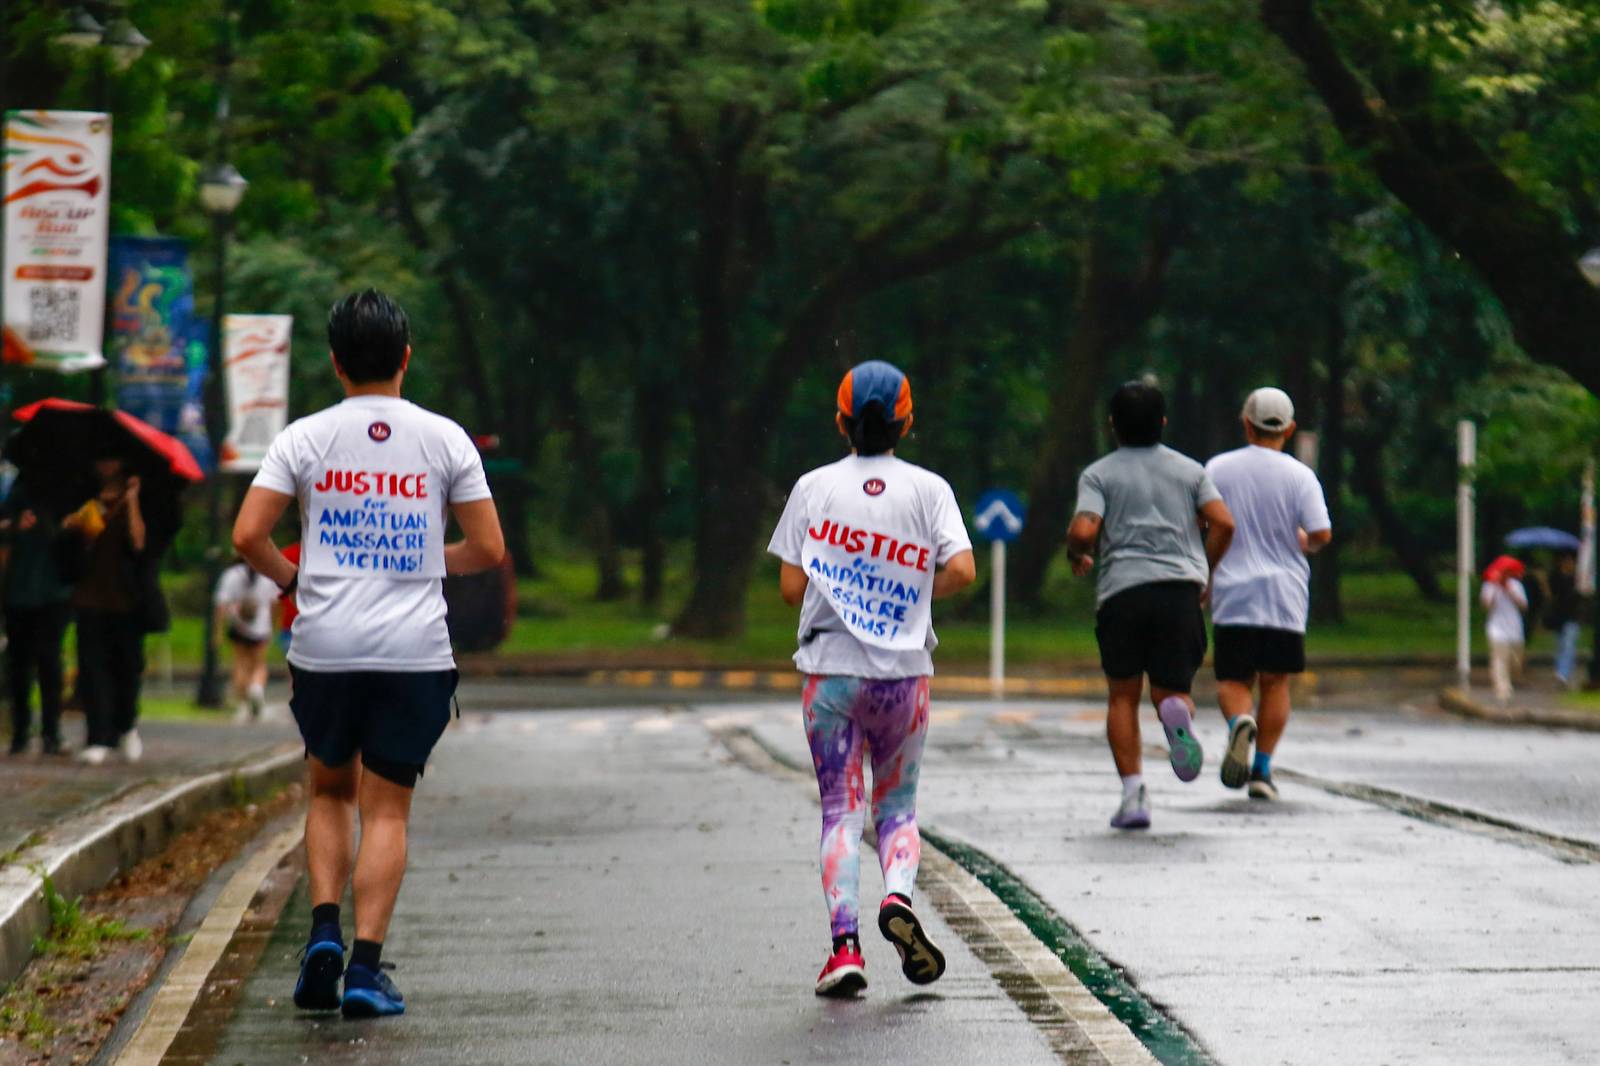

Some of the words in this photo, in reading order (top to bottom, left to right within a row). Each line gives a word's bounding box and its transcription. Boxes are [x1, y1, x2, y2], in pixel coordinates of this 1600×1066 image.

[315, 469, 428, 499] JUSTICE
[364, 497, 388, 509] for
[319, 507, 427, 530] AMPATUAN
[319, 529, 427, 550] MASSACRE
[808, 519, 930, 572] JUSTICE
[334, 551, 424, 573] VICTIMS!
[853, 557, 880, 573] for
[809, 557, 921, 605] AMPATUAN
[827, 585, 908, 622] SSACRE
[842, 608, 899, 641] TIMS!
